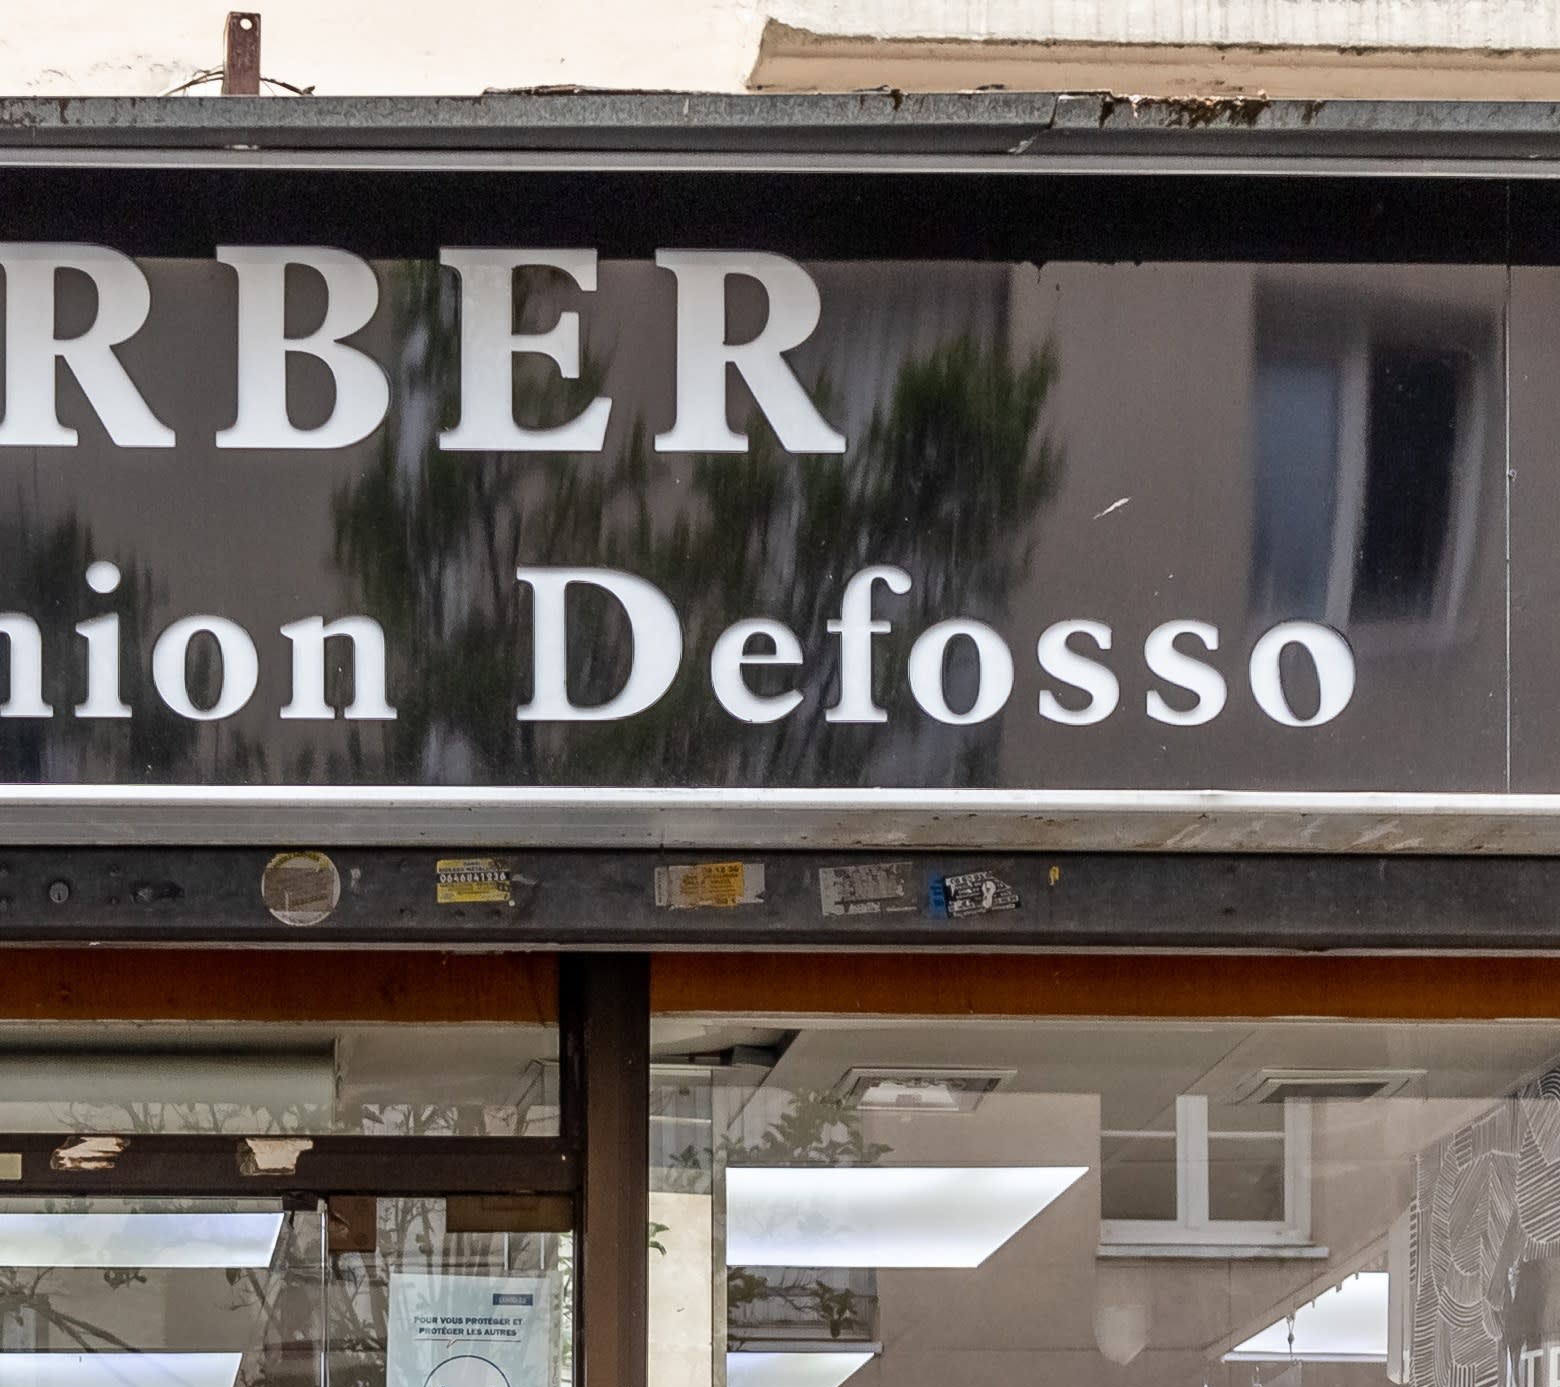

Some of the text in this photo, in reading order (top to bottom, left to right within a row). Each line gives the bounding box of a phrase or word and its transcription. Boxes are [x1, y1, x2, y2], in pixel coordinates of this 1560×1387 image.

[516, 567, 1356, 728] Defosso
[414, 1315, 523, 1326] POUR VOUS PROTÉGER ET
[418, 1325, 517, 1337] PROTÉGER LES AUTRES
